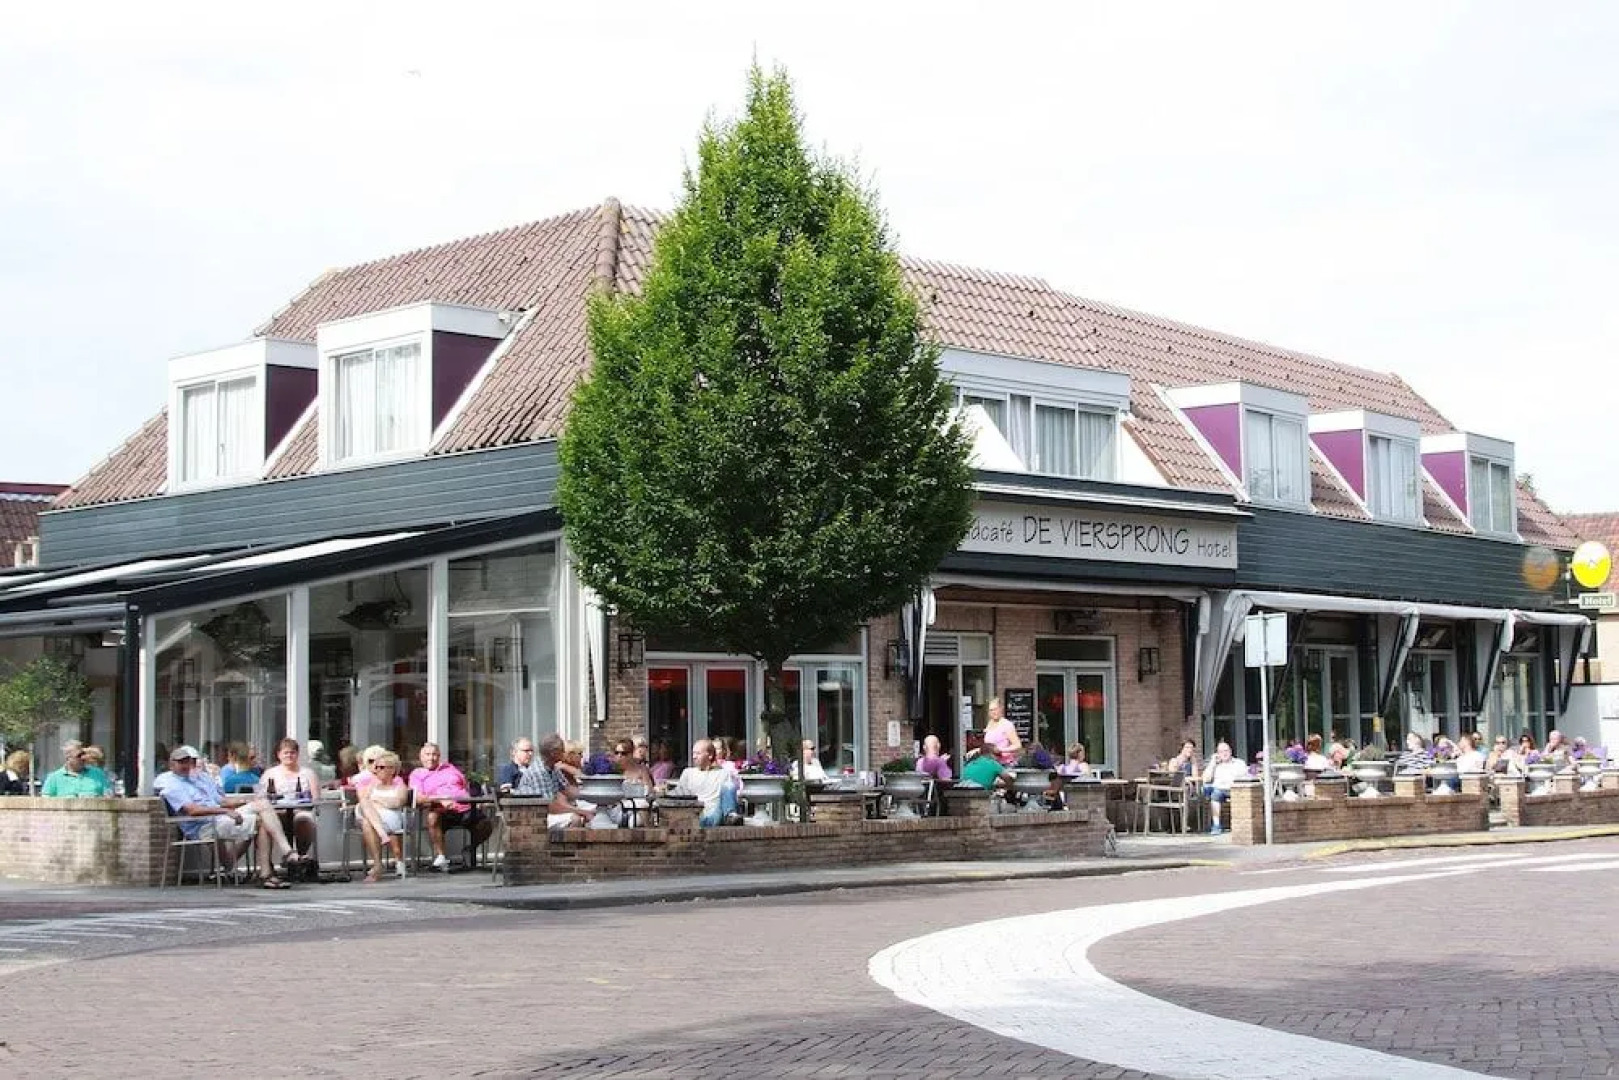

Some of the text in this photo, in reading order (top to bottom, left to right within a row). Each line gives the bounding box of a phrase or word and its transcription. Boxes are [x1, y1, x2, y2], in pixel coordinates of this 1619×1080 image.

[1023, 515, 1051, 544] DE
[1060, 518, 1190, 555] VIERSPRONG
[1197, 537, 1232, 558] Hotel
